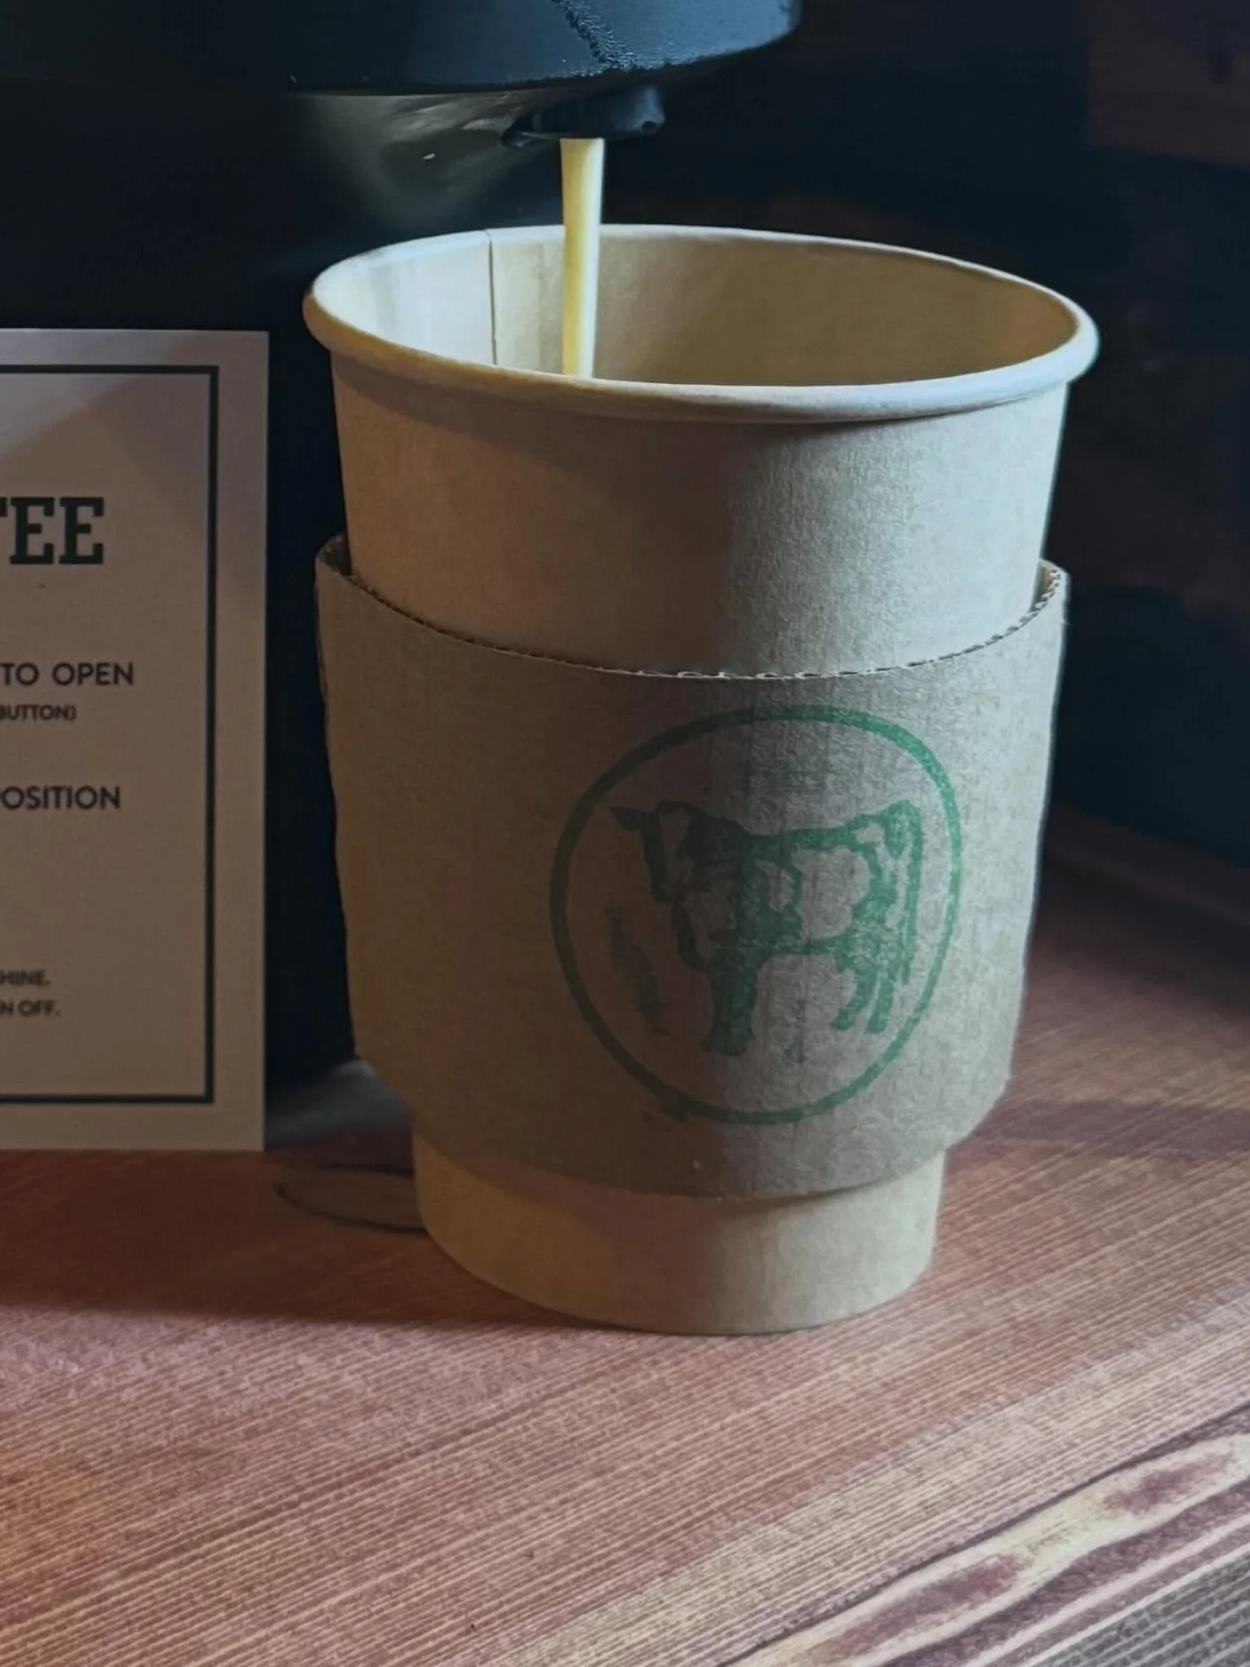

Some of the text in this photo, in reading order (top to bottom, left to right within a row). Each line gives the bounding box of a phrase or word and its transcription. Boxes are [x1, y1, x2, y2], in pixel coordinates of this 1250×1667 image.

[0, 662, 40, 687] TO
[51, 661, 134, 687] OPEN
[17, 999, 59, 1017] OFF.
